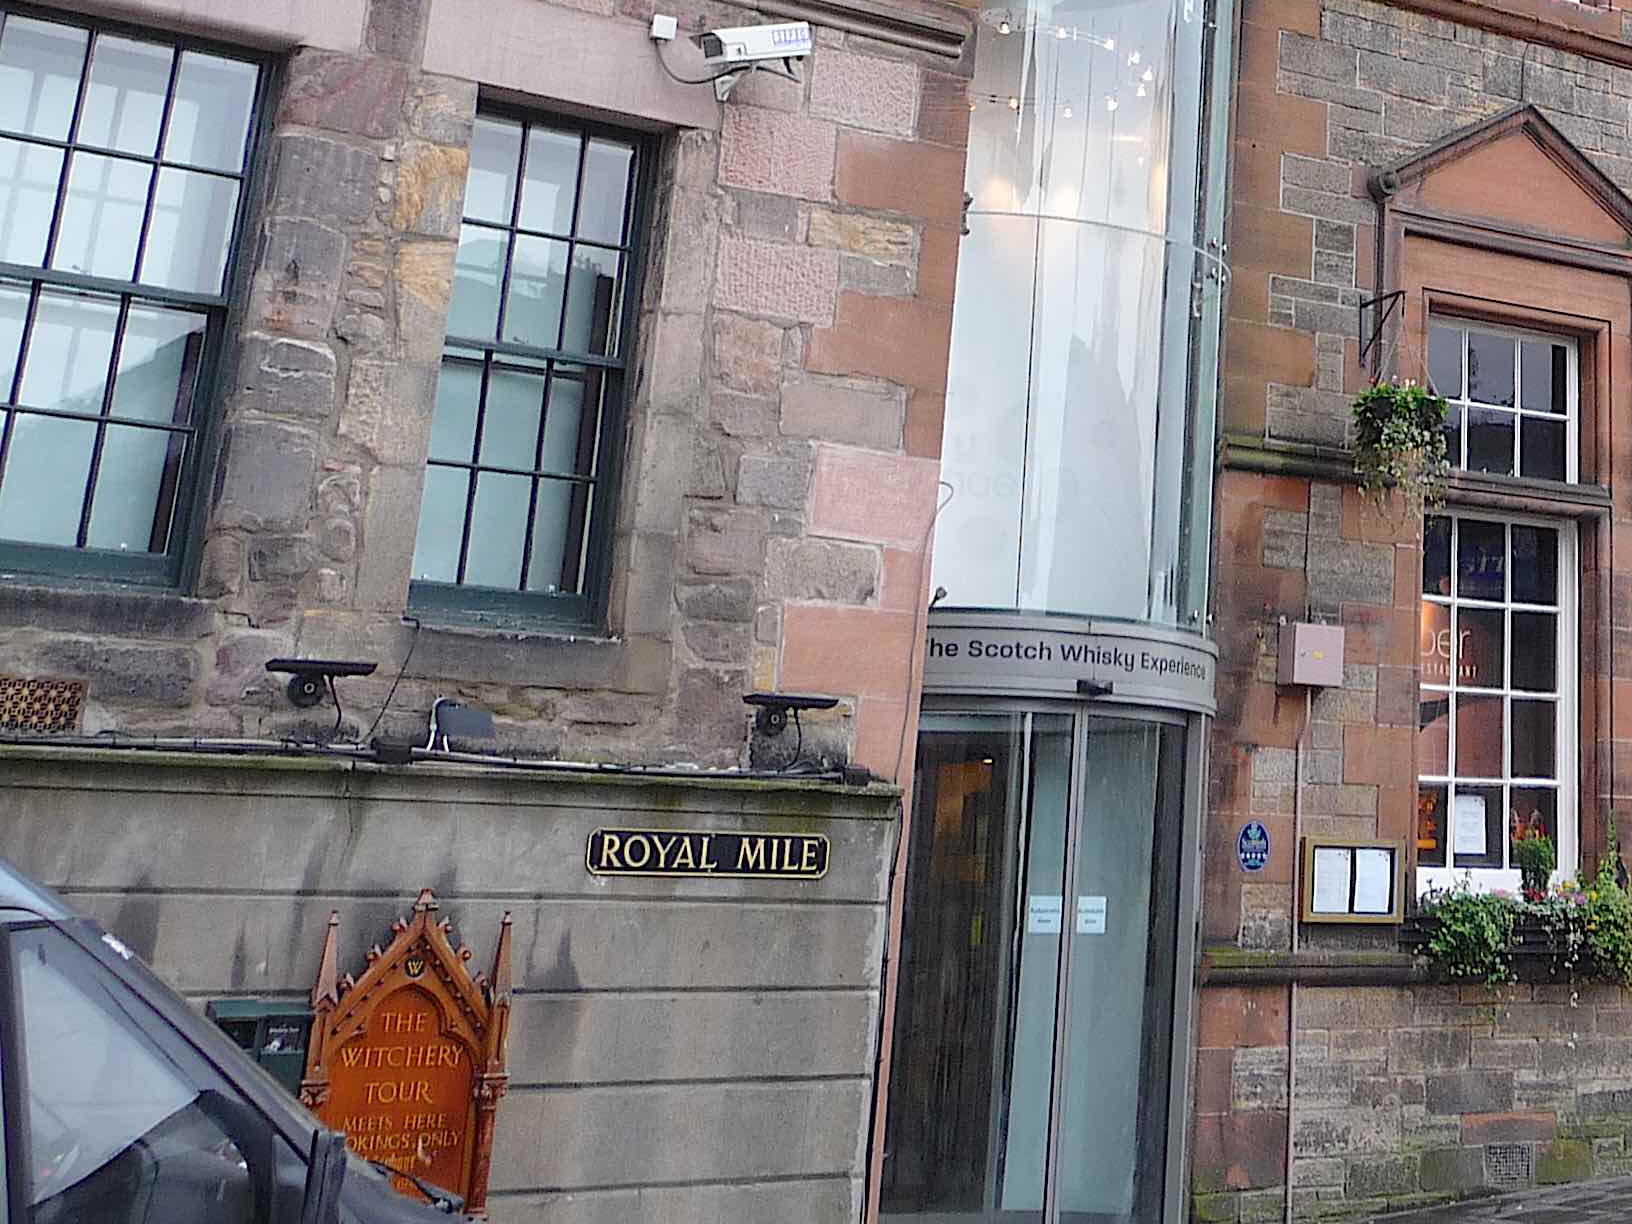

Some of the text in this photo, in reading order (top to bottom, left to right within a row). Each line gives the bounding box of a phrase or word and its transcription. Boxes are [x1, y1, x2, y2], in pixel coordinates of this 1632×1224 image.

[926, 637, 1206, 681] he Scotch Whisky Experience
[601, 834, 820, 872] ROYAL MILE
[407, 959, 424, 976] W
[382, 1011, 429, 1033] THE
[341, 1045, 464, 1069] WITCHERY
[364, 1079, 434, 1105] TOUR
[342, 1112, 448, 1133] MEETS HERE
[345, 1132, 410, 1152] OKINGS
